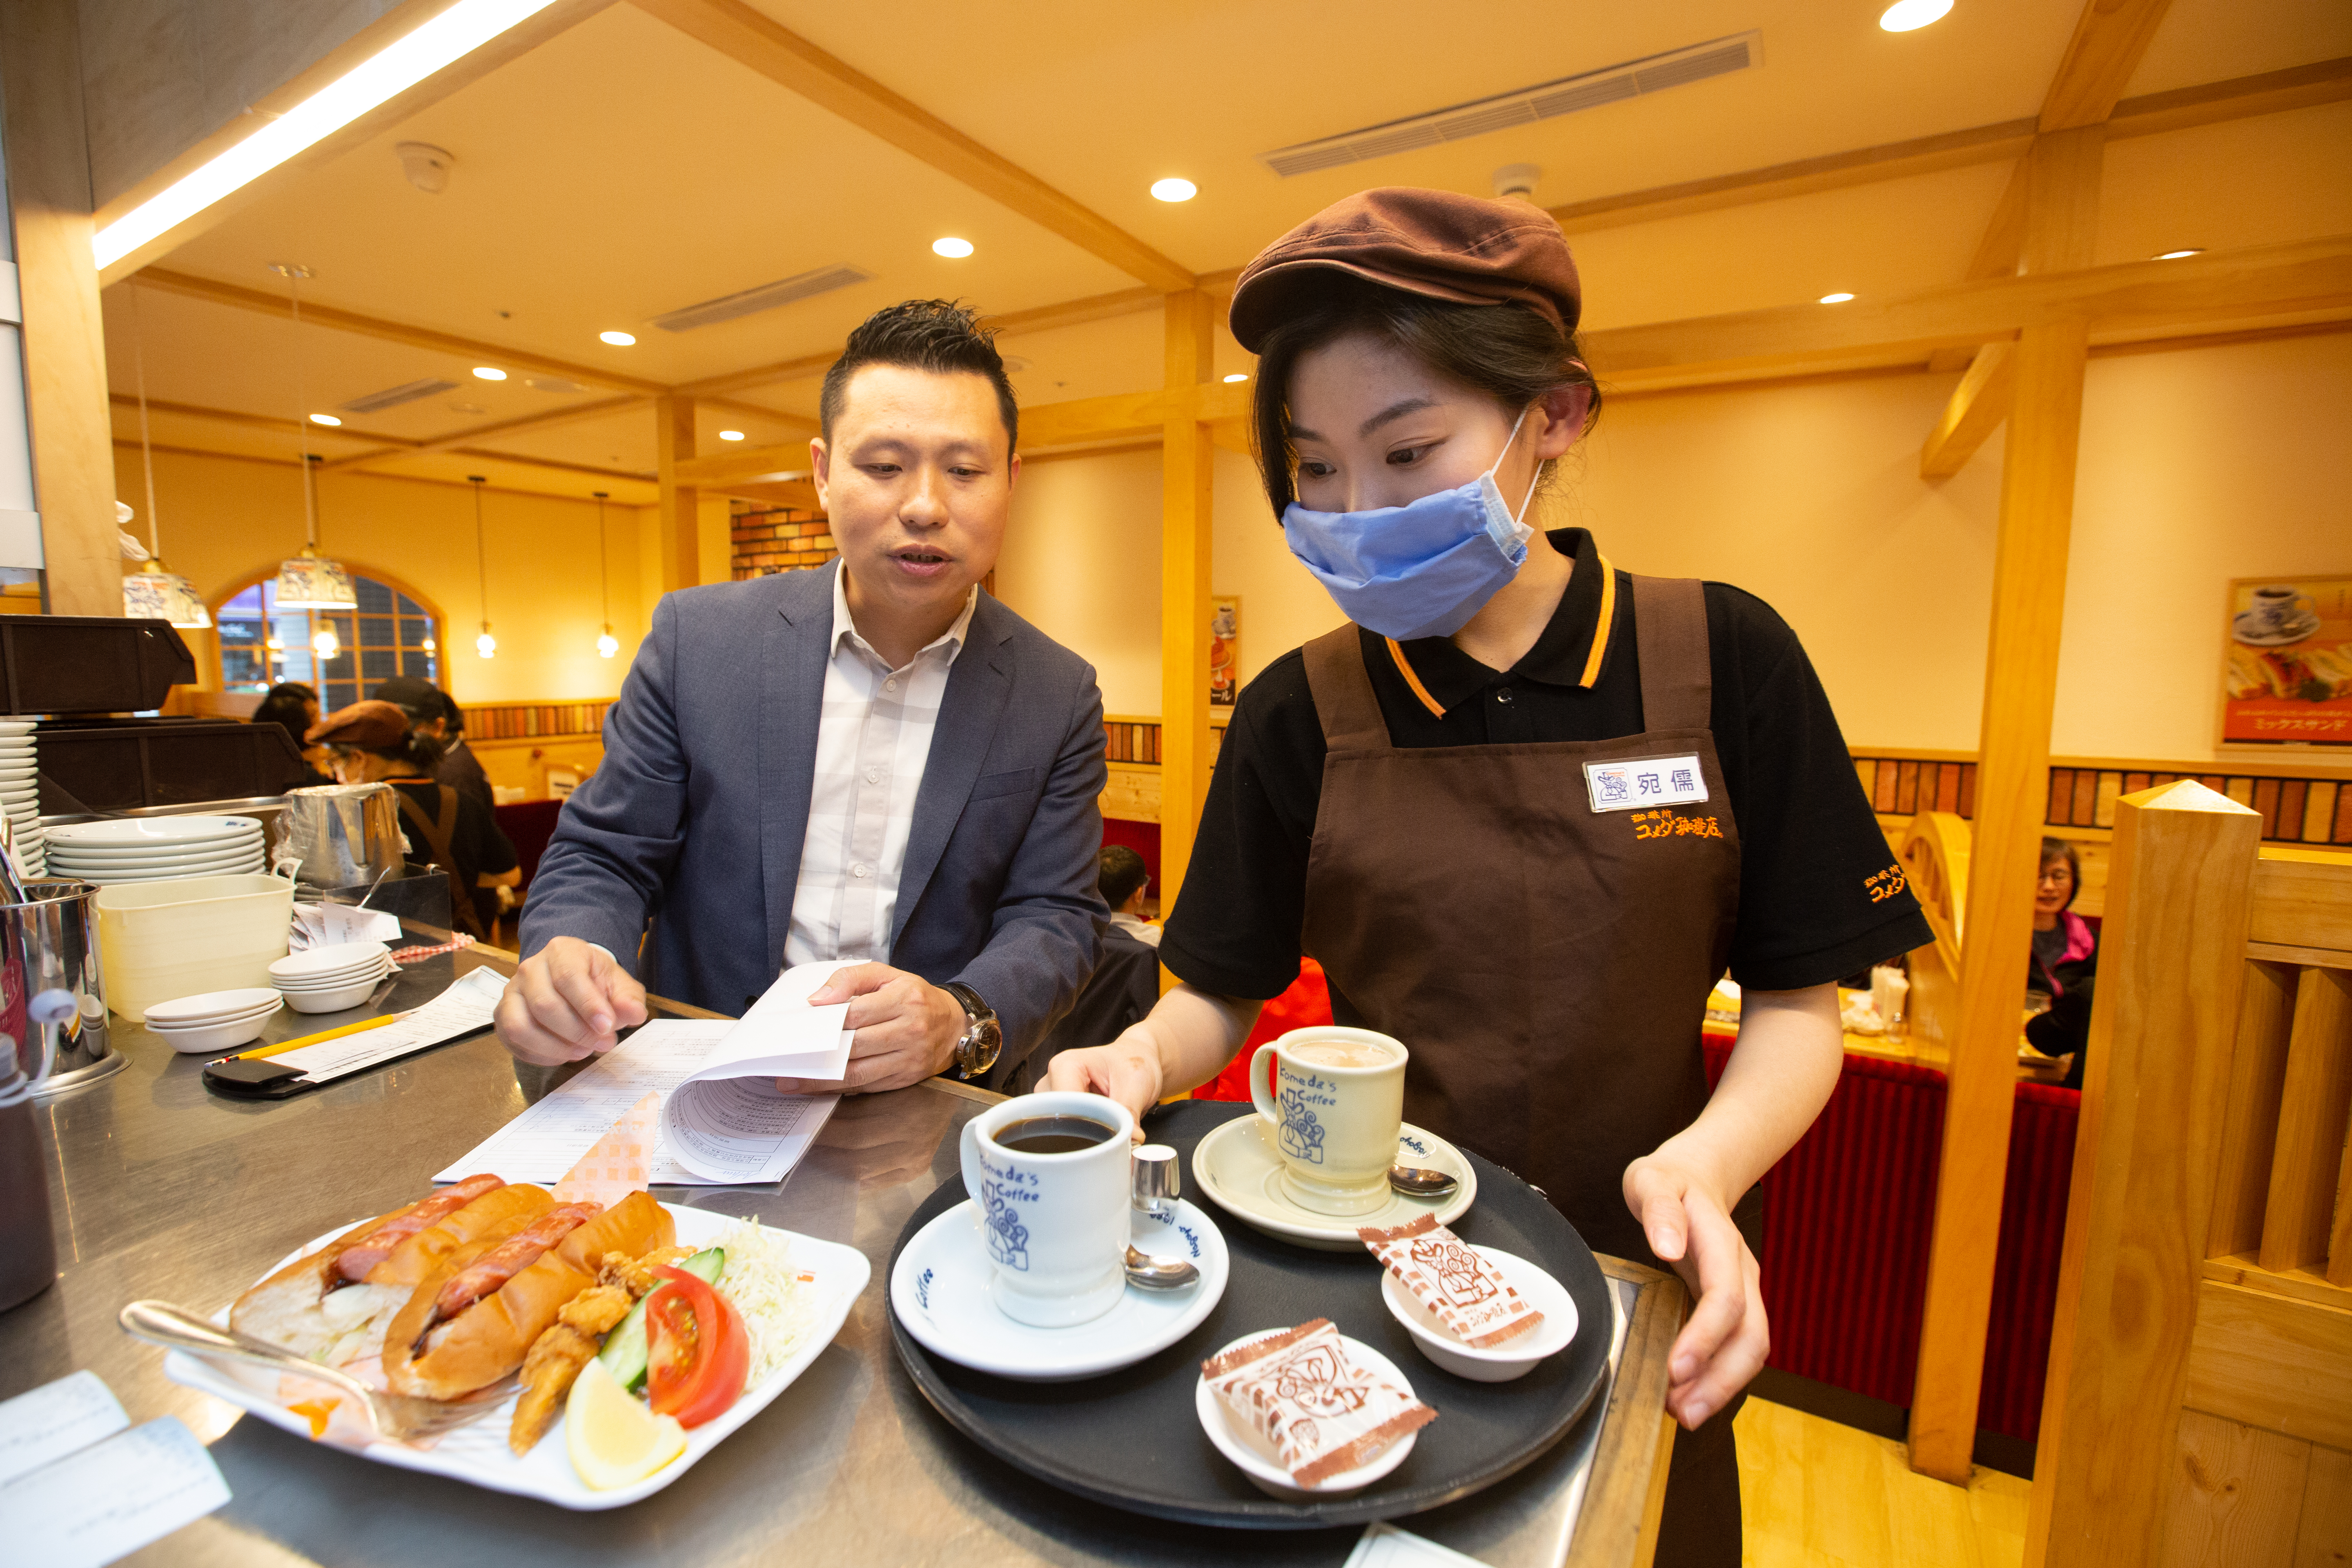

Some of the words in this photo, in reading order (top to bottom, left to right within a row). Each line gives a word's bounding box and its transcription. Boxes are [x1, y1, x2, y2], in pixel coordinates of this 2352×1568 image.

[1280, 1060, 1337, 1092] Komeda's
[1297, 1089, 1336, 1106] Coffee
[996, 1183, 1040, 1202] Coffee
[1178, 1226, 1201, 1258] Nagoya
